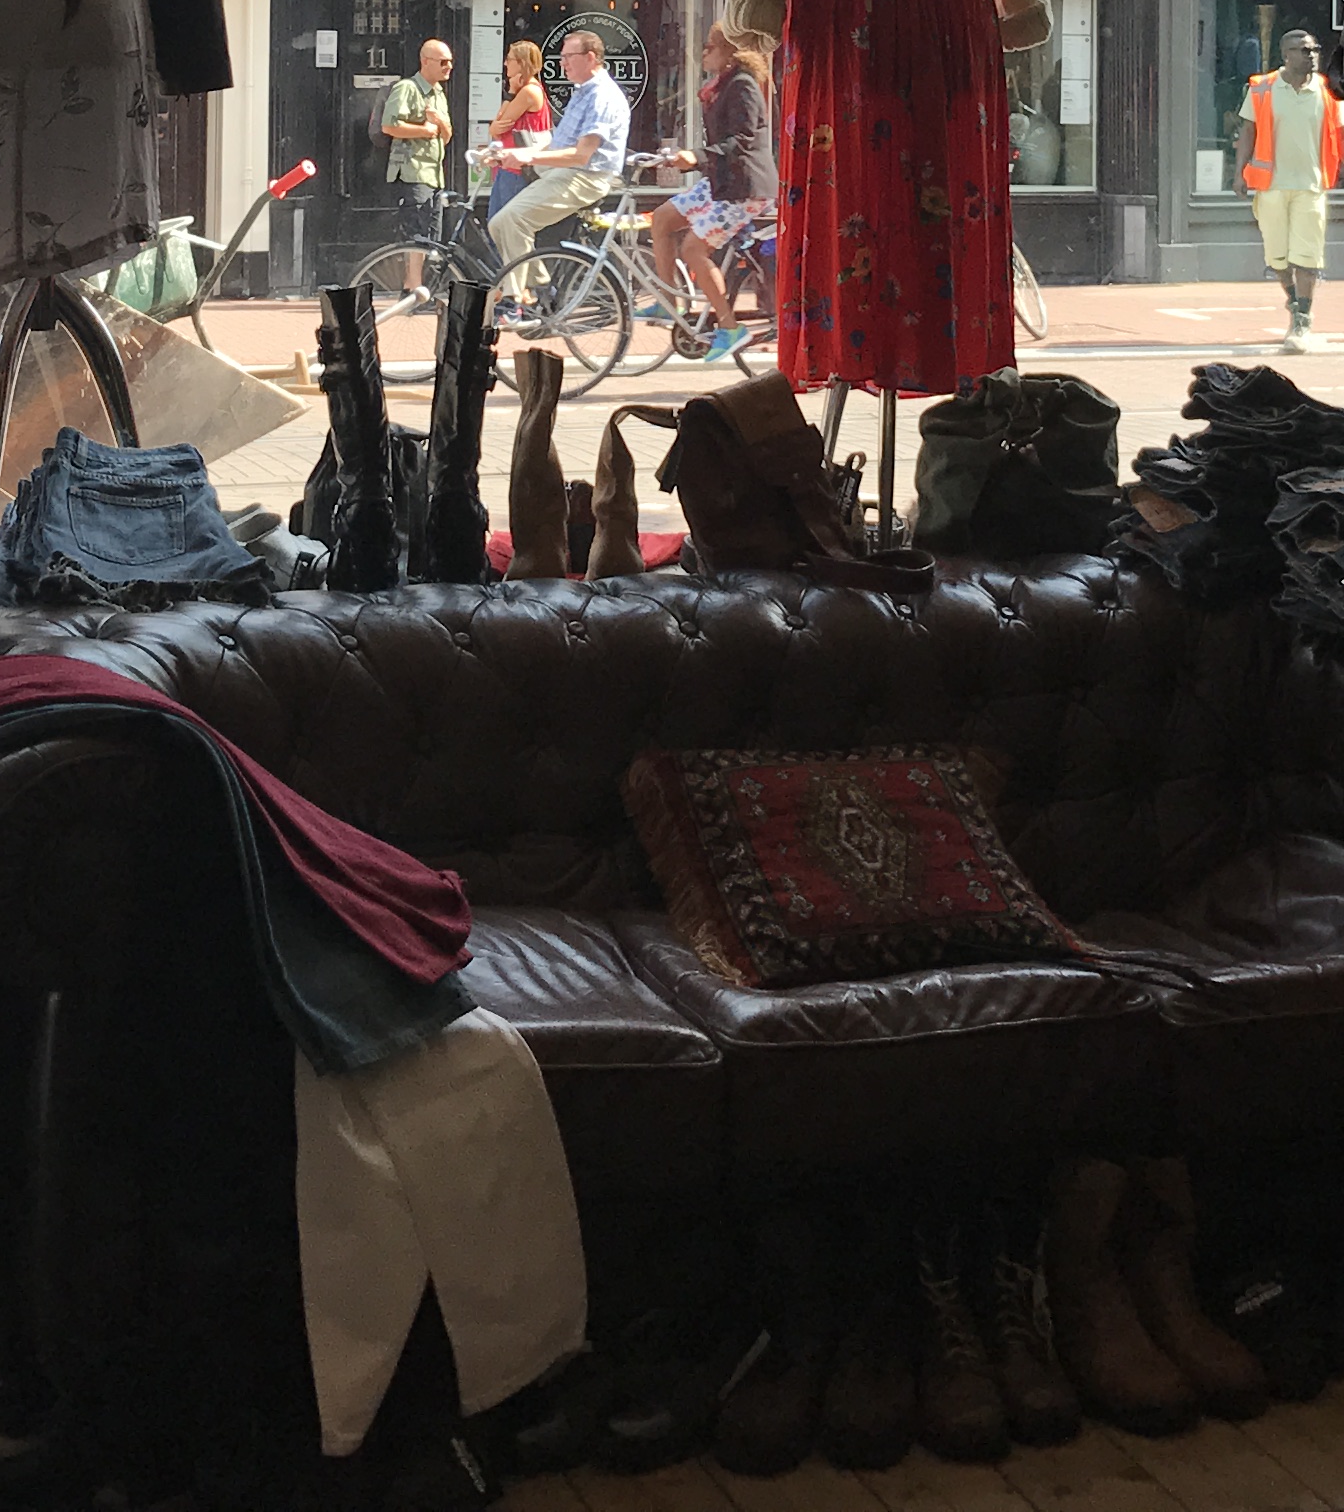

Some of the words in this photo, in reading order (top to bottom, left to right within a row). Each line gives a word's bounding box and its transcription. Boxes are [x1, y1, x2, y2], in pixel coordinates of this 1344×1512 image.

[548, 28, 567, 49] FRESH
[567, 18, 586, 30] FOOD
[593, 17, 616, 27] GREAT
[616, 26, 639, 50] PEOPLE
[366, 48, 388, 68] 11
[543, 60, 643, 80] SIEL
